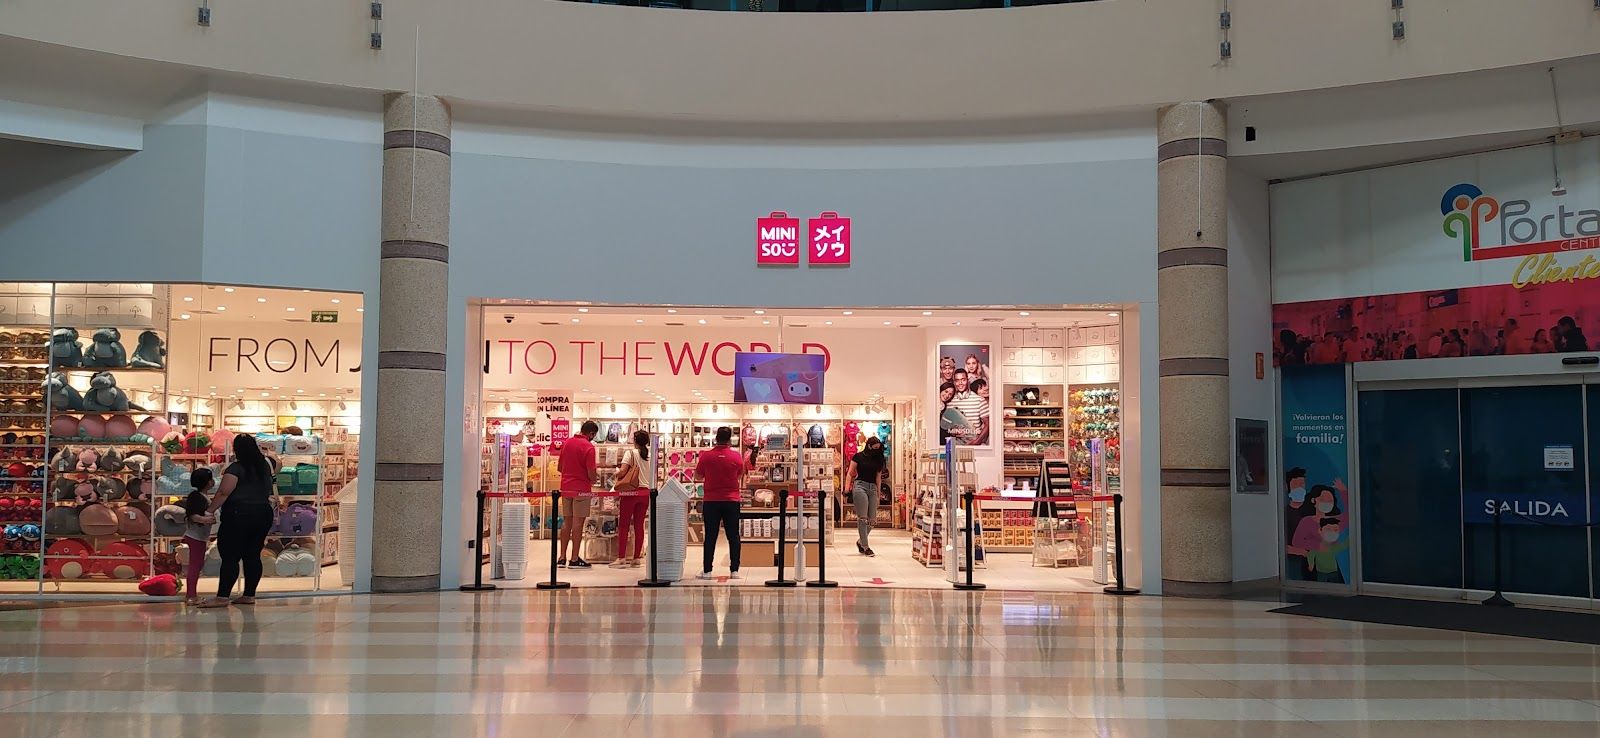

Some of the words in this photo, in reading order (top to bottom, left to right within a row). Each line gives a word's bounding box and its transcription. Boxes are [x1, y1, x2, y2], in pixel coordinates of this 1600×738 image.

[761, 227, 796, 241] MINI
[813, 225, 845, 242] メイ
[815, 241, 845, 257] ソウ
[208, 337, 340, 374] FROM
[498, 340, 557, 375] TO
[570, 341, 656, 376] THE
[545, 404, 569, 412] LÍNEA
[1293, 413, 1331, 421] ¡Volvieron
[1332, 413, 1344, 421] los
[1296, 432, 1345, 444] familia!
[1484, 499, 1569, 518] SALIDA
